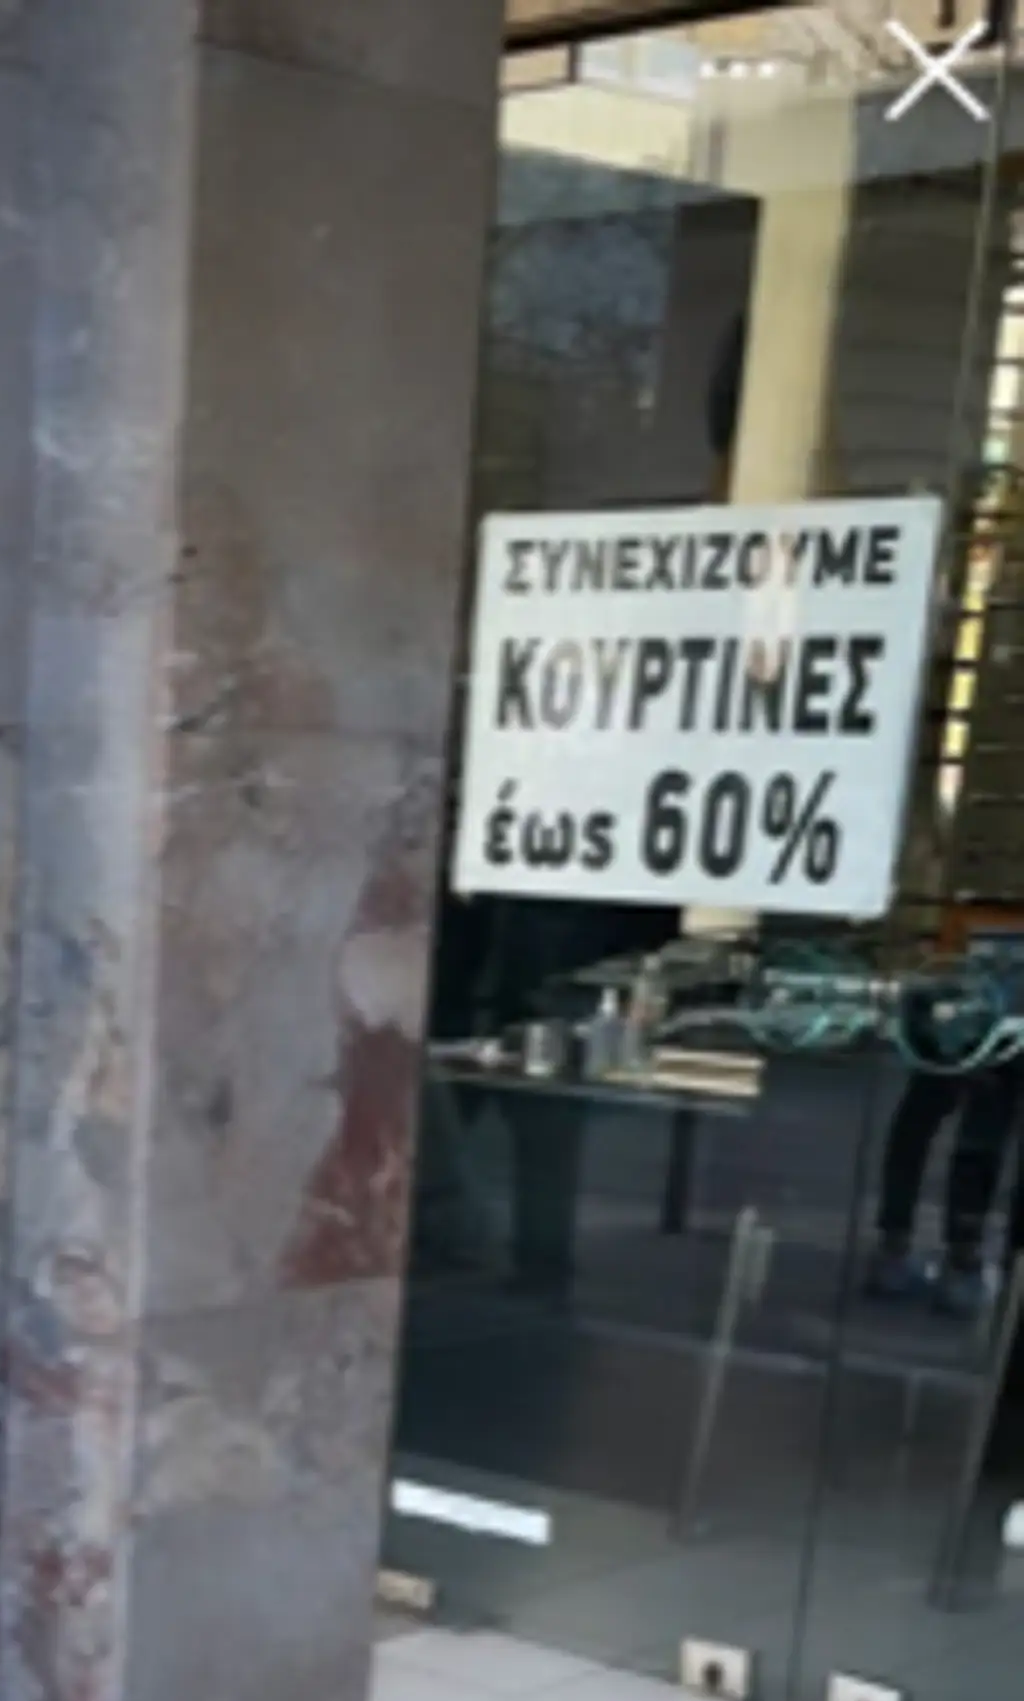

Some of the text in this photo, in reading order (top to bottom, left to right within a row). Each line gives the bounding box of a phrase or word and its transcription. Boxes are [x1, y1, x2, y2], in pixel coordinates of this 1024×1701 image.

[501, 525, 901, 595] ΣΥΝΕΧΙΖΟΥΜΕ
[494, 634, 884, 736] ΚΟΥΡΤΙΝΕΣ
[483, 769, 842, 887] έως 60%
